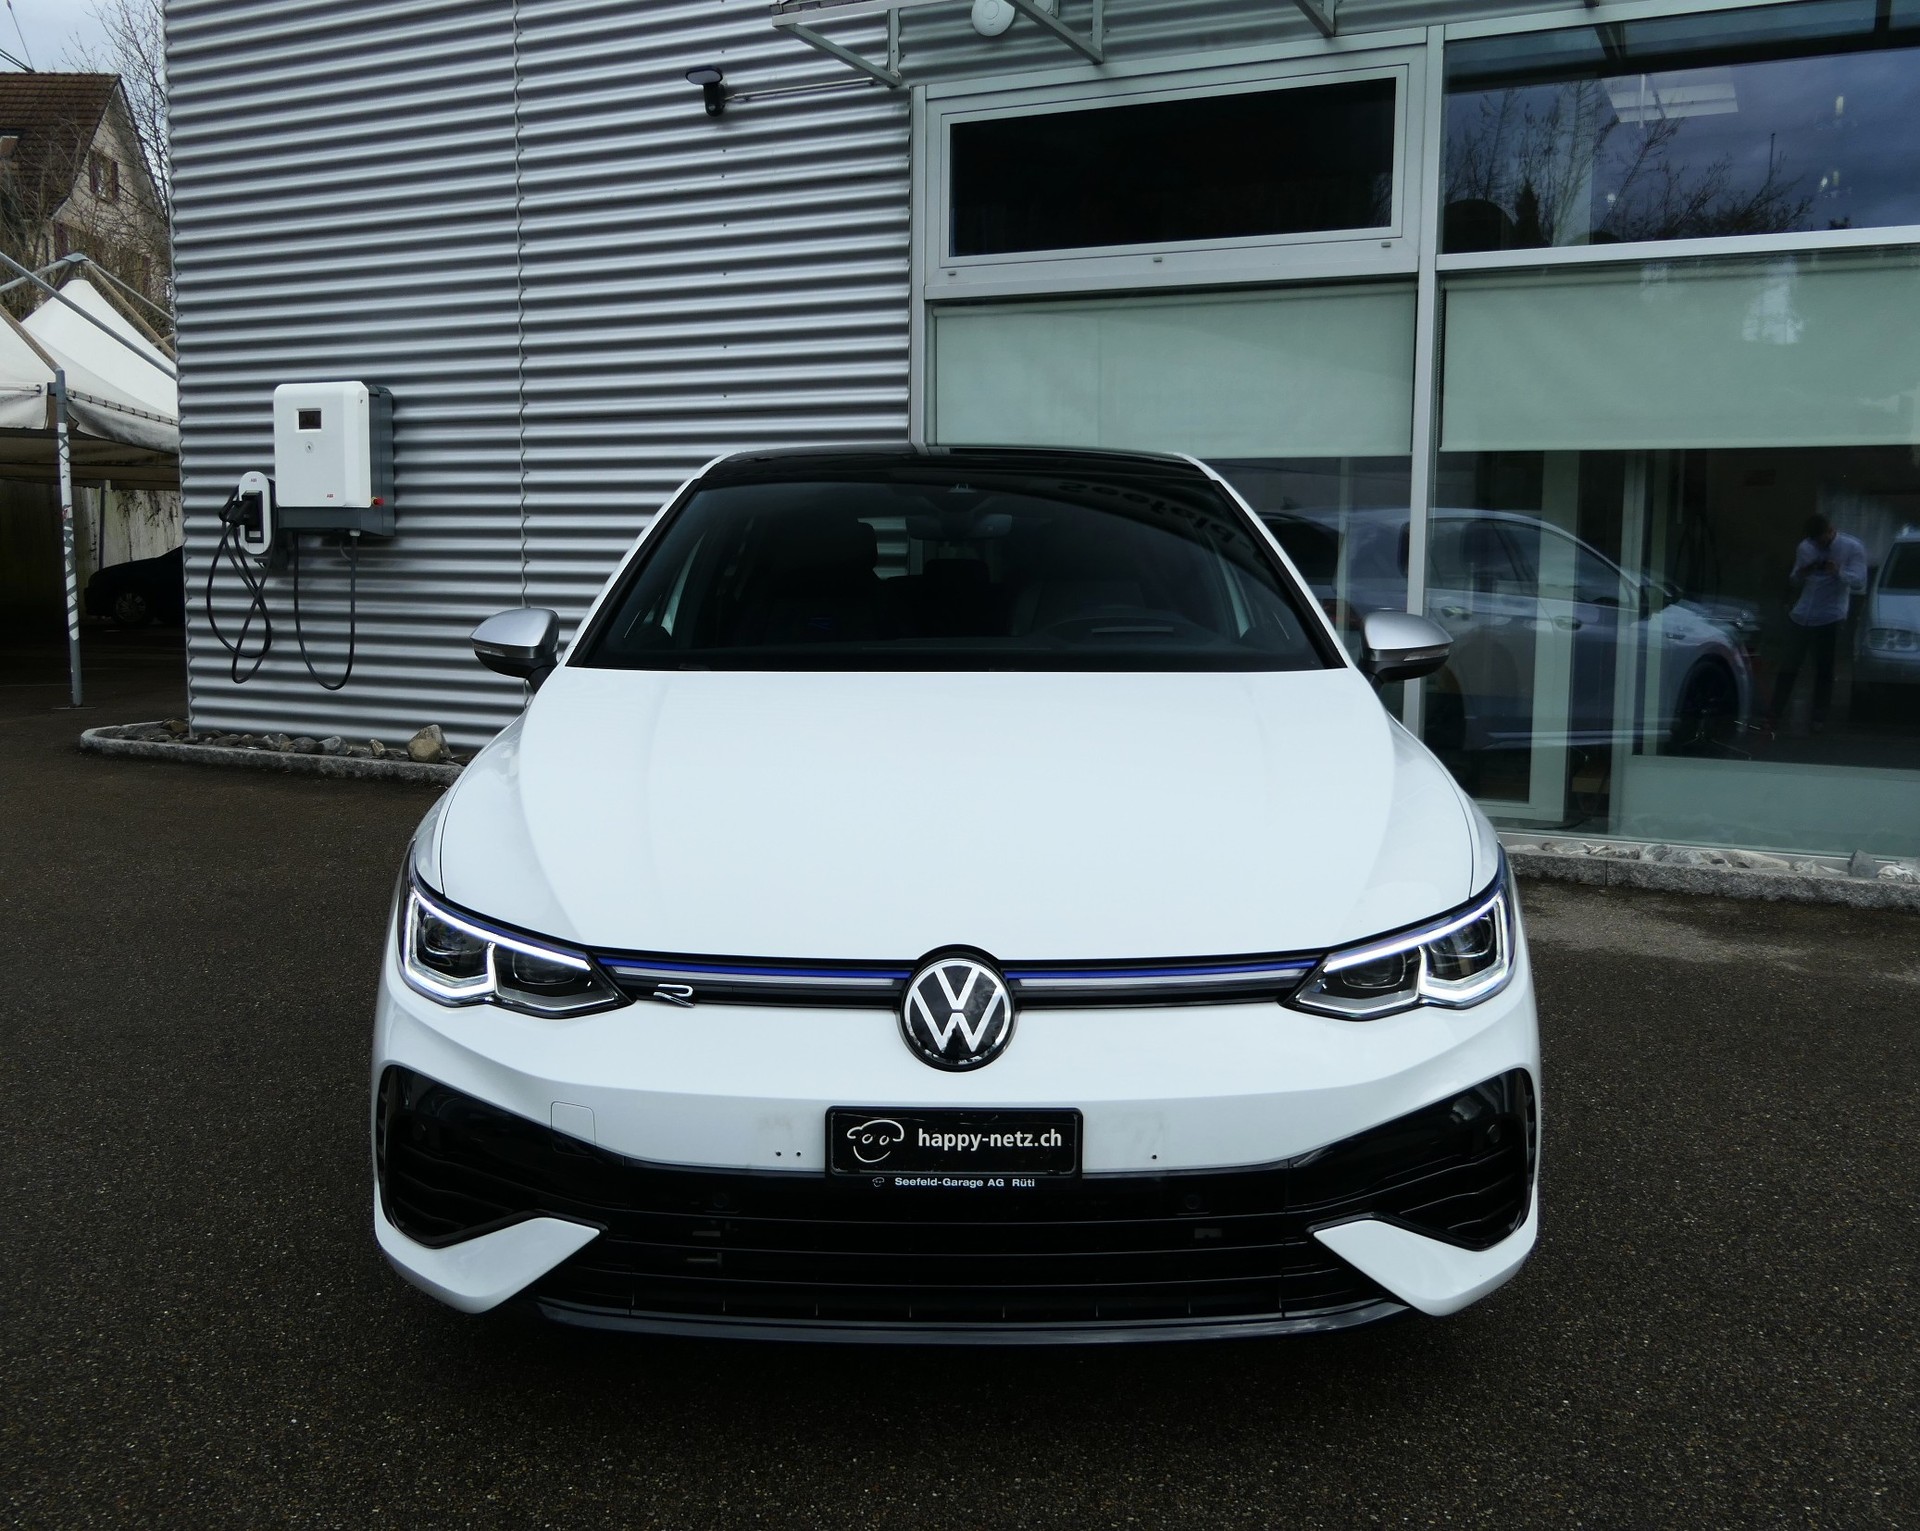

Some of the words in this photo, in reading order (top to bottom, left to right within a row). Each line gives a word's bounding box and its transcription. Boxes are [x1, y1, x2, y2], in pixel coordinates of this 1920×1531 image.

[653, 984, 695, 1009] R
[909, 963, 1003, 1053] VW
[918, 1128, 1062, 1151] happy-netz.ch
[894, 1177, 984, 1189] Seefeld-Garage
[987, 1178, 1005, 1188] AG
[1011, 1177, 1036, 1188] Rüti
